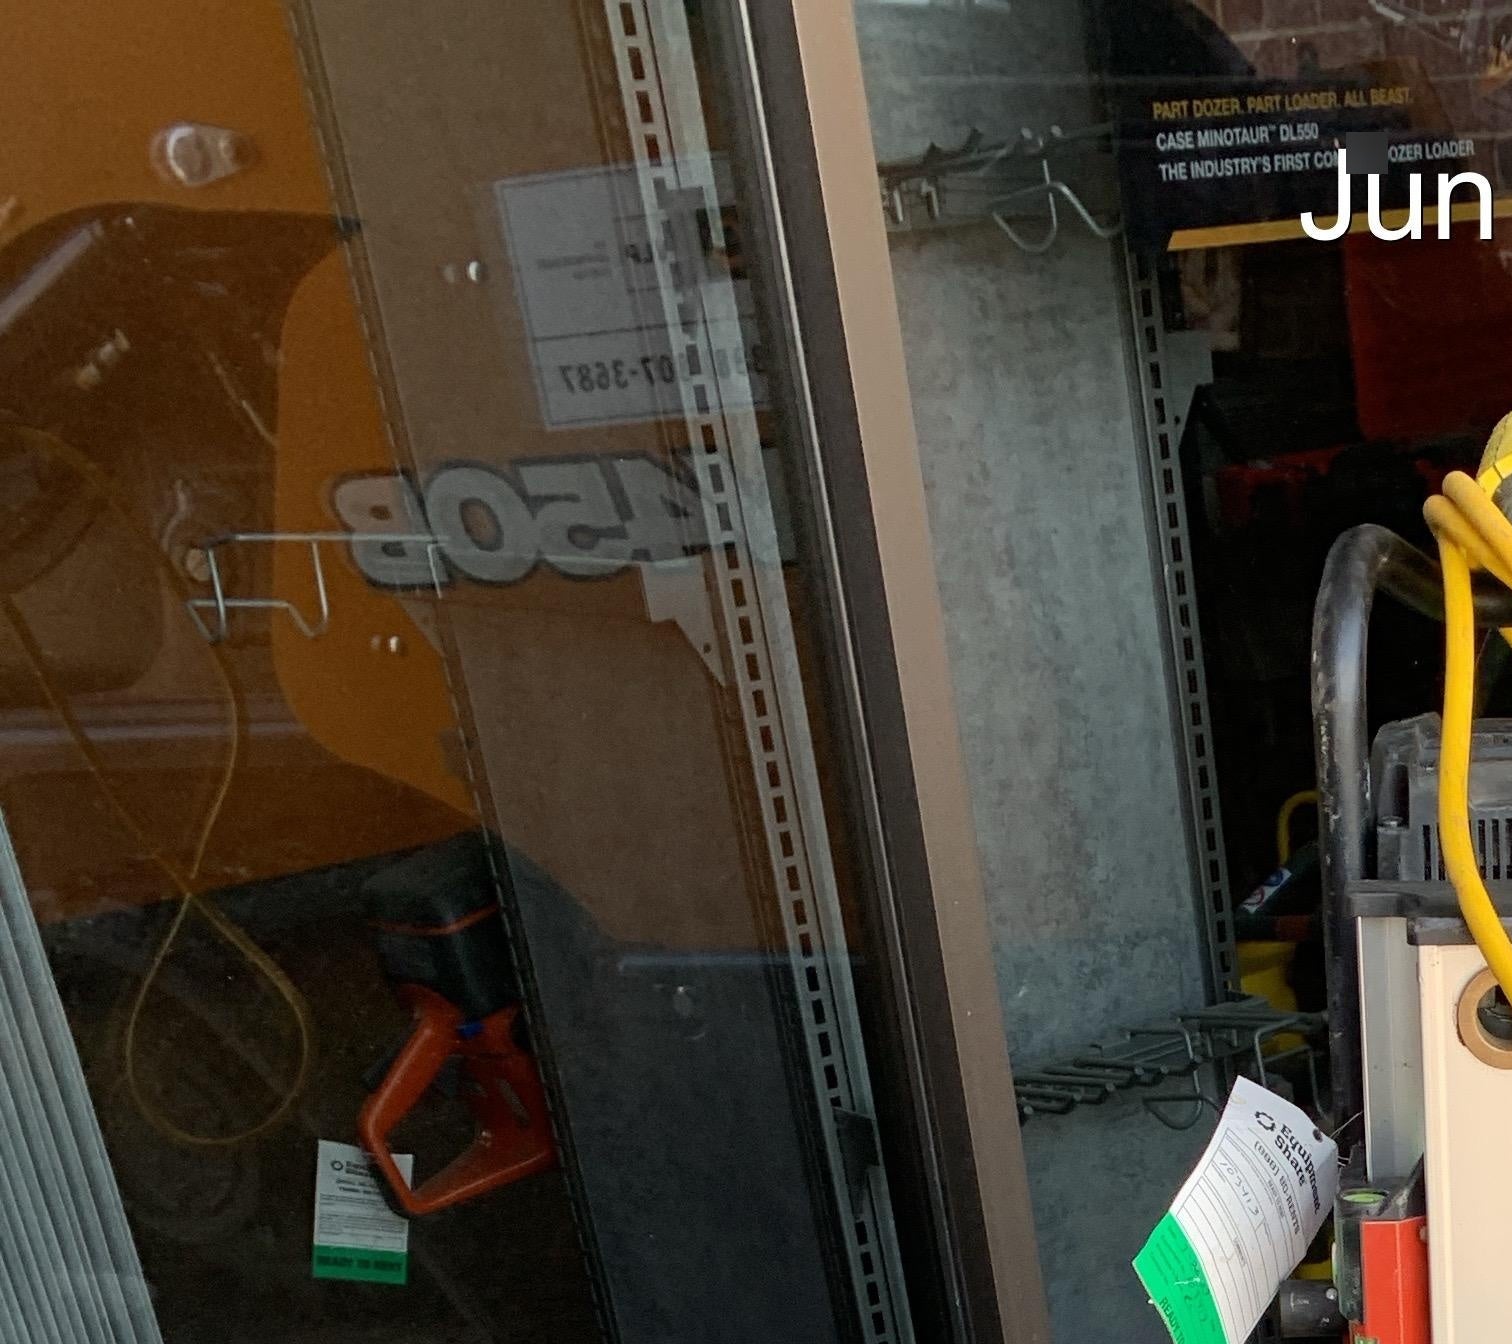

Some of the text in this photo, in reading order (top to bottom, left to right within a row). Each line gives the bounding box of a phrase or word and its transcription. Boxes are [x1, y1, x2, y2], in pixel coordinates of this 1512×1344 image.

[1153, 100, 1189, 120] PART
[1246, 94, 1282, 114] PART
[1344, 89, 1368, 108] ALL
[1155, 130, 1196, 151] CASE
[1279, 121, 1320, 143] DL550
[1158, 161, 1189, 181] THE
[1189, 155, 1272, 179] INDUSTRY'S
[1273, 151, 1313, 173] FIRST
[1388, 144, 1424, 163] OZER
[1425, 138, 1476, 160] LOADER
[1274, 1134, 1307, 1187] Share
[1280, 1123, 1321, 1216] Equipment
